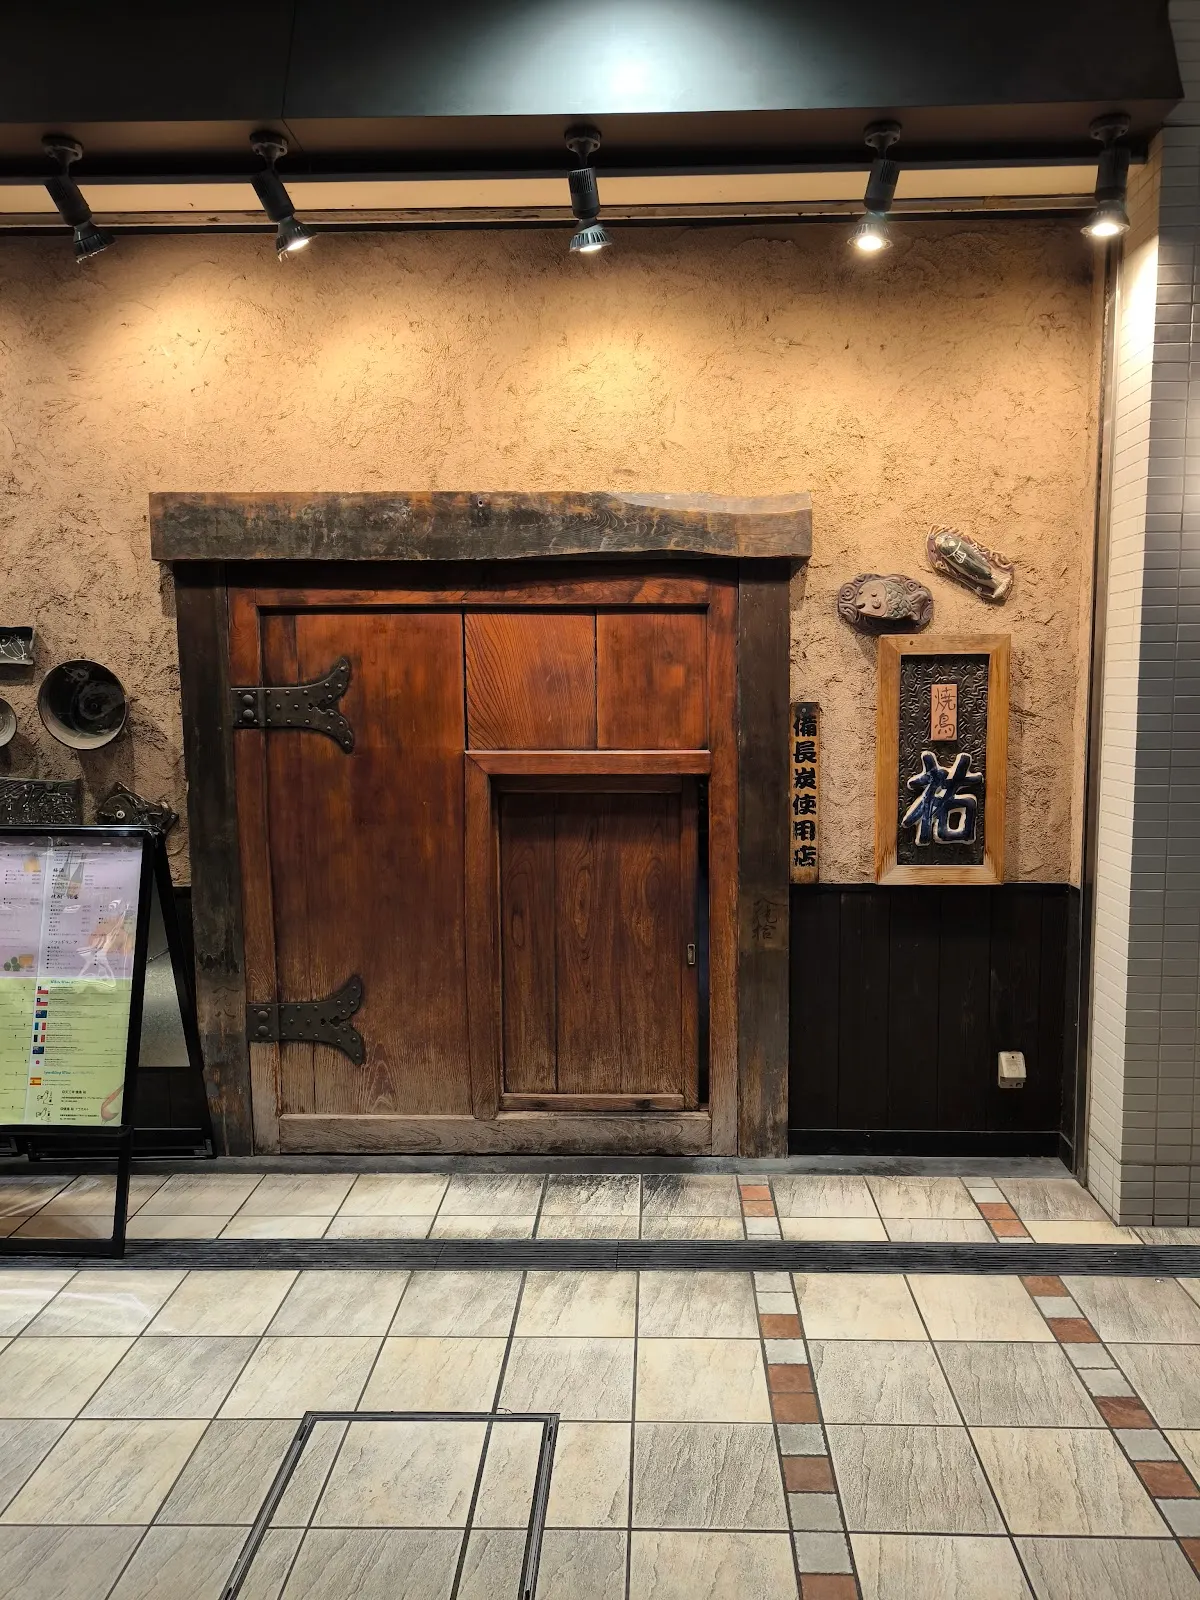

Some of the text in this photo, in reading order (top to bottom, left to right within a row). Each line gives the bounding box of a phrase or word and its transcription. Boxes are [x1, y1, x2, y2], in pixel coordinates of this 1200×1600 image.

[934, 687, 957, 740] 焼鳥
[792, 715, 818, 868] 備長炭使用店
[901, 750, 984, 846] 祐
